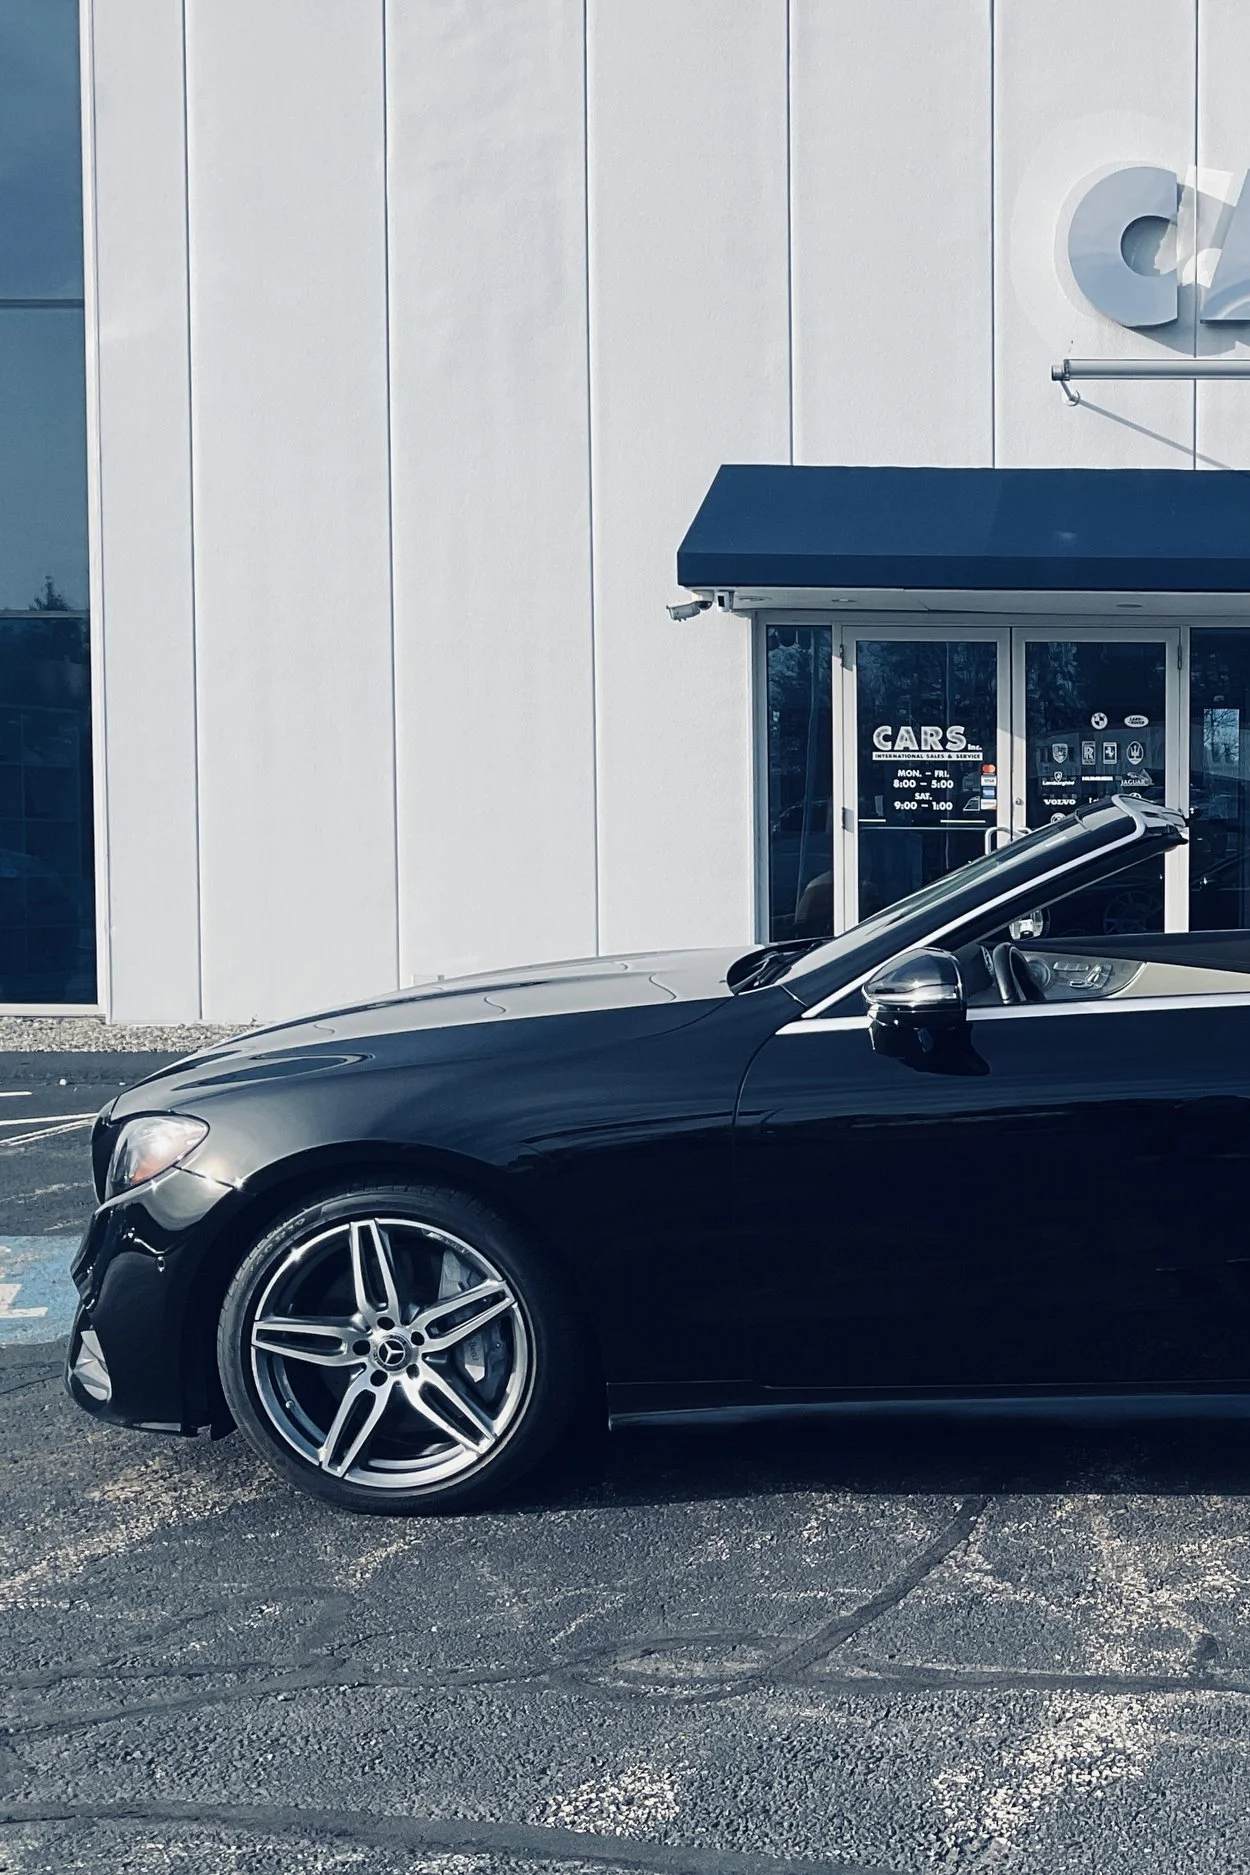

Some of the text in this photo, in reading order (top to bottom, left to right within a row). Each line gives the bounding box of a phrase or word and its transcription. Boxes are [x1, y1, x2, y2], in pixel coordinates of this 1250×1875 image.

[873, 725, 967, 751] CARS
[897, 769, 922, 778] MON.
[934, 769, 950, 778] FRI.
[893, 779, 917, 788] 8:00
[930, 780, 954, 789] 5:00
[914, 792, 933, 800] SAT.
[893, 801, 918, 810] 9:00
[931, 801, 953, 810] 1:00
[1043, 798, 1077, 806] VOLVO
